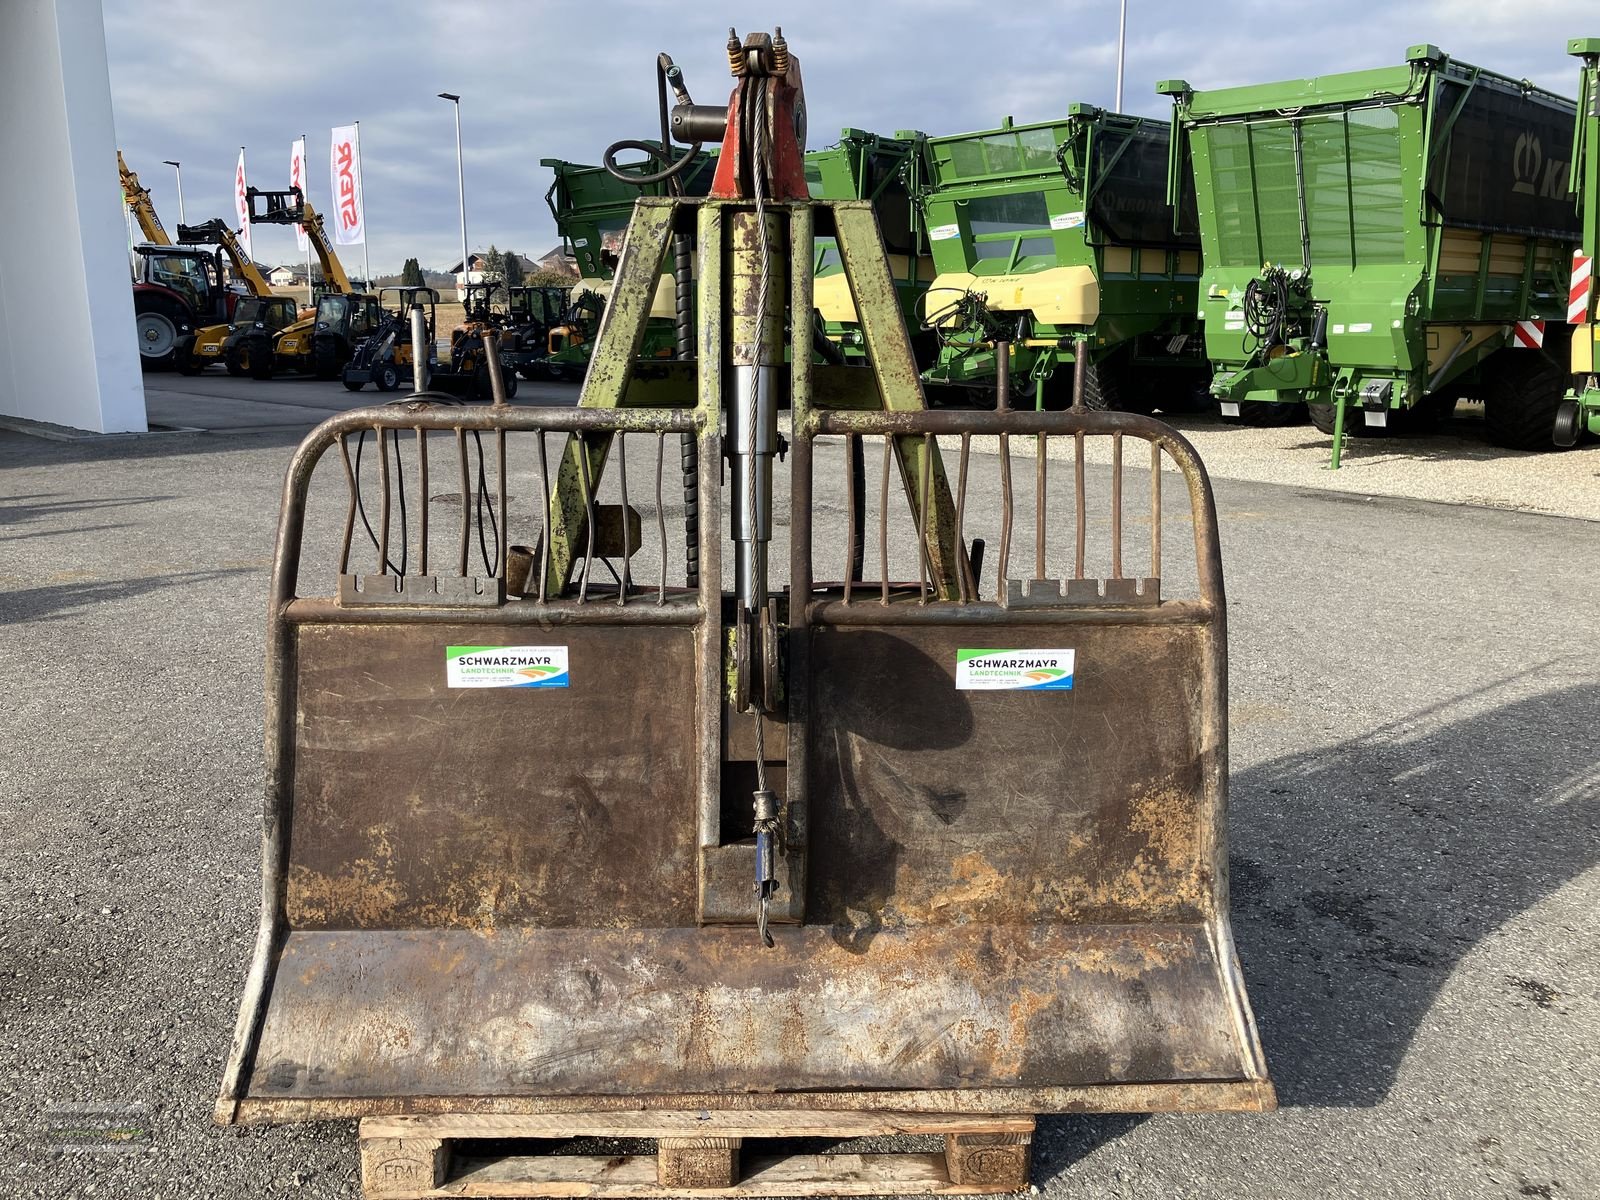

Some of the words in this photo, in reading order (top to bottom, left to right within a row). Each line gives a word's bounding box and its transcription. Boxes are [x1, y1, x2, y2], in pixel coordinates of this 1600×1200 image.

[319, 229, 334, 252] JCB
[233, 243, 250, 266] JCB
[458, 656, 551, 666] SCHWARZMAYR
[968, 659, 1058, 668] SCHWARZMAYR
